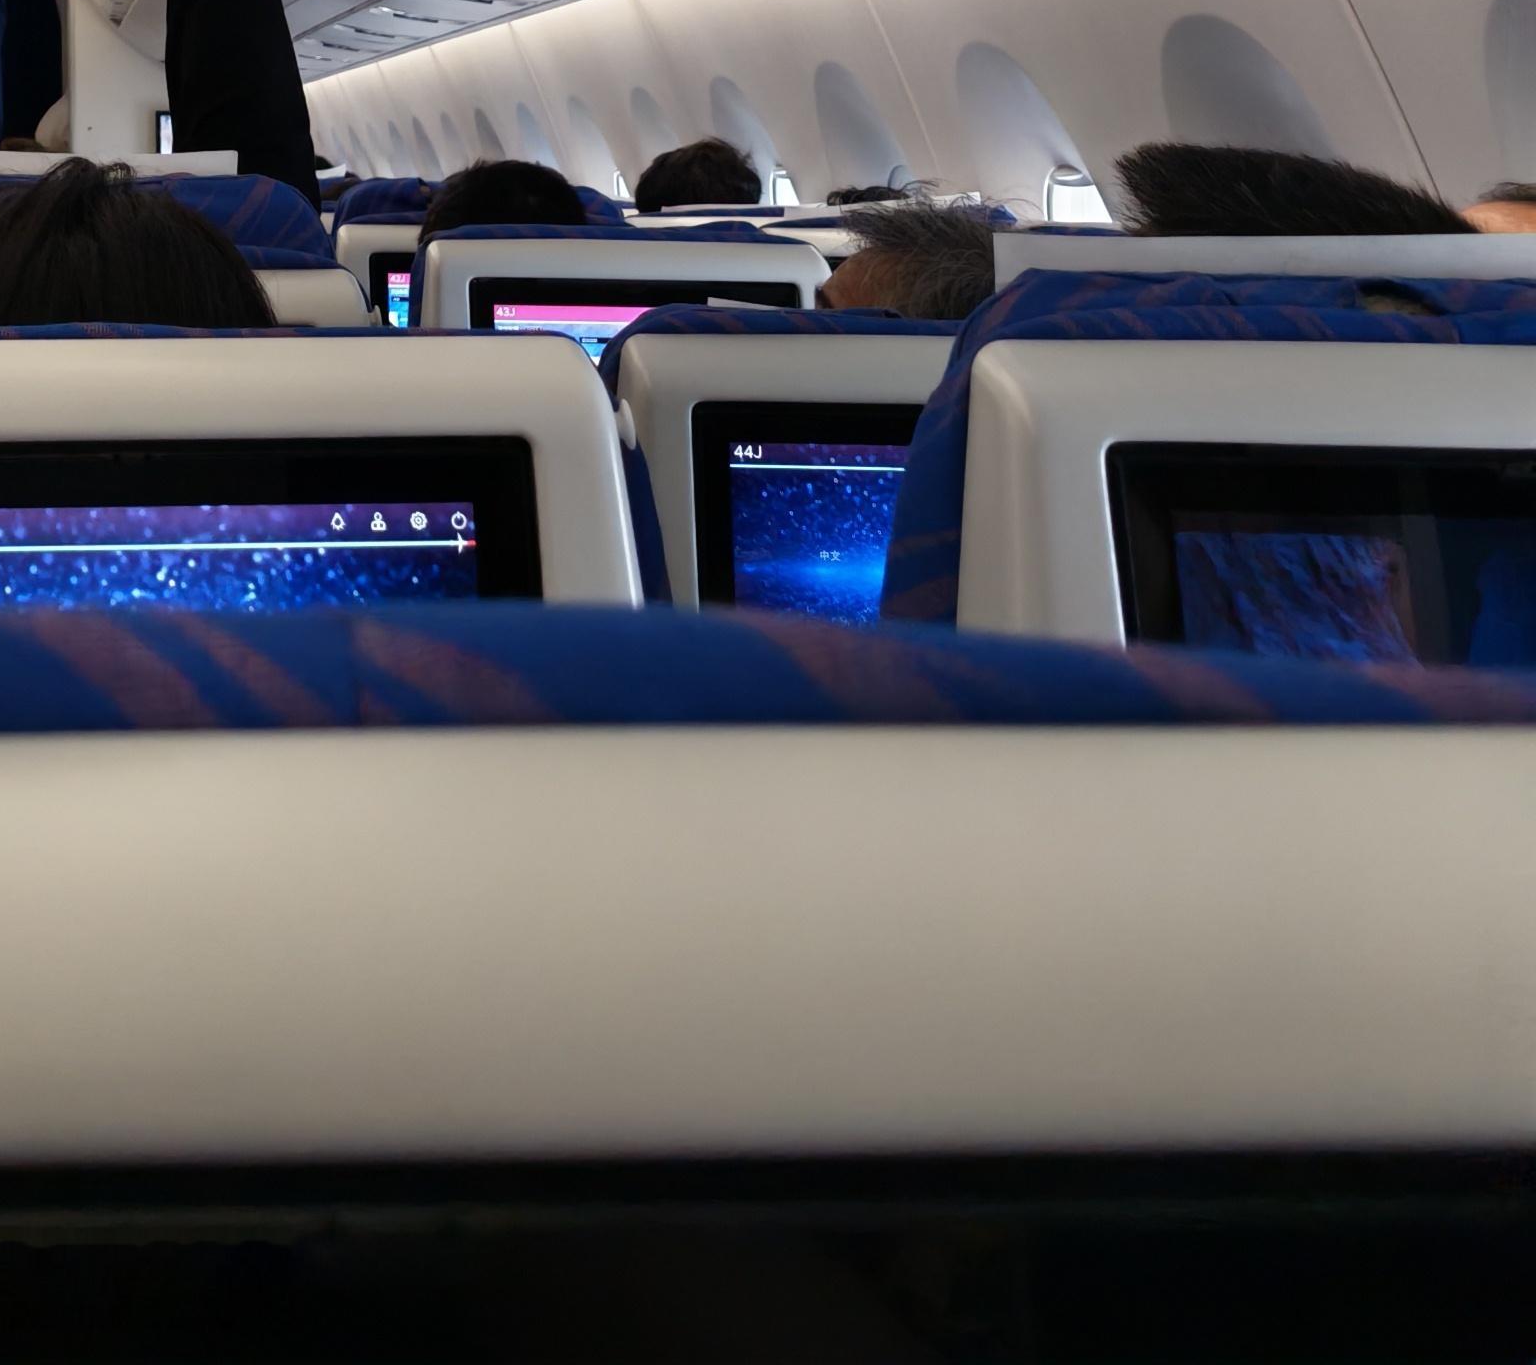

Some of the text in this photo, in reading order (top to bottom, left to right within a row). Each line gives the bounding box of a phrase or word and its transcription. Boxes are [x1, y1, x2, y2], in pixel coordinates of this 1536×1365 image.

[496, 306, 516, 317] 43J
[733, 444, 763, 459] 44J
[819, 549, 841, 562] 中文
